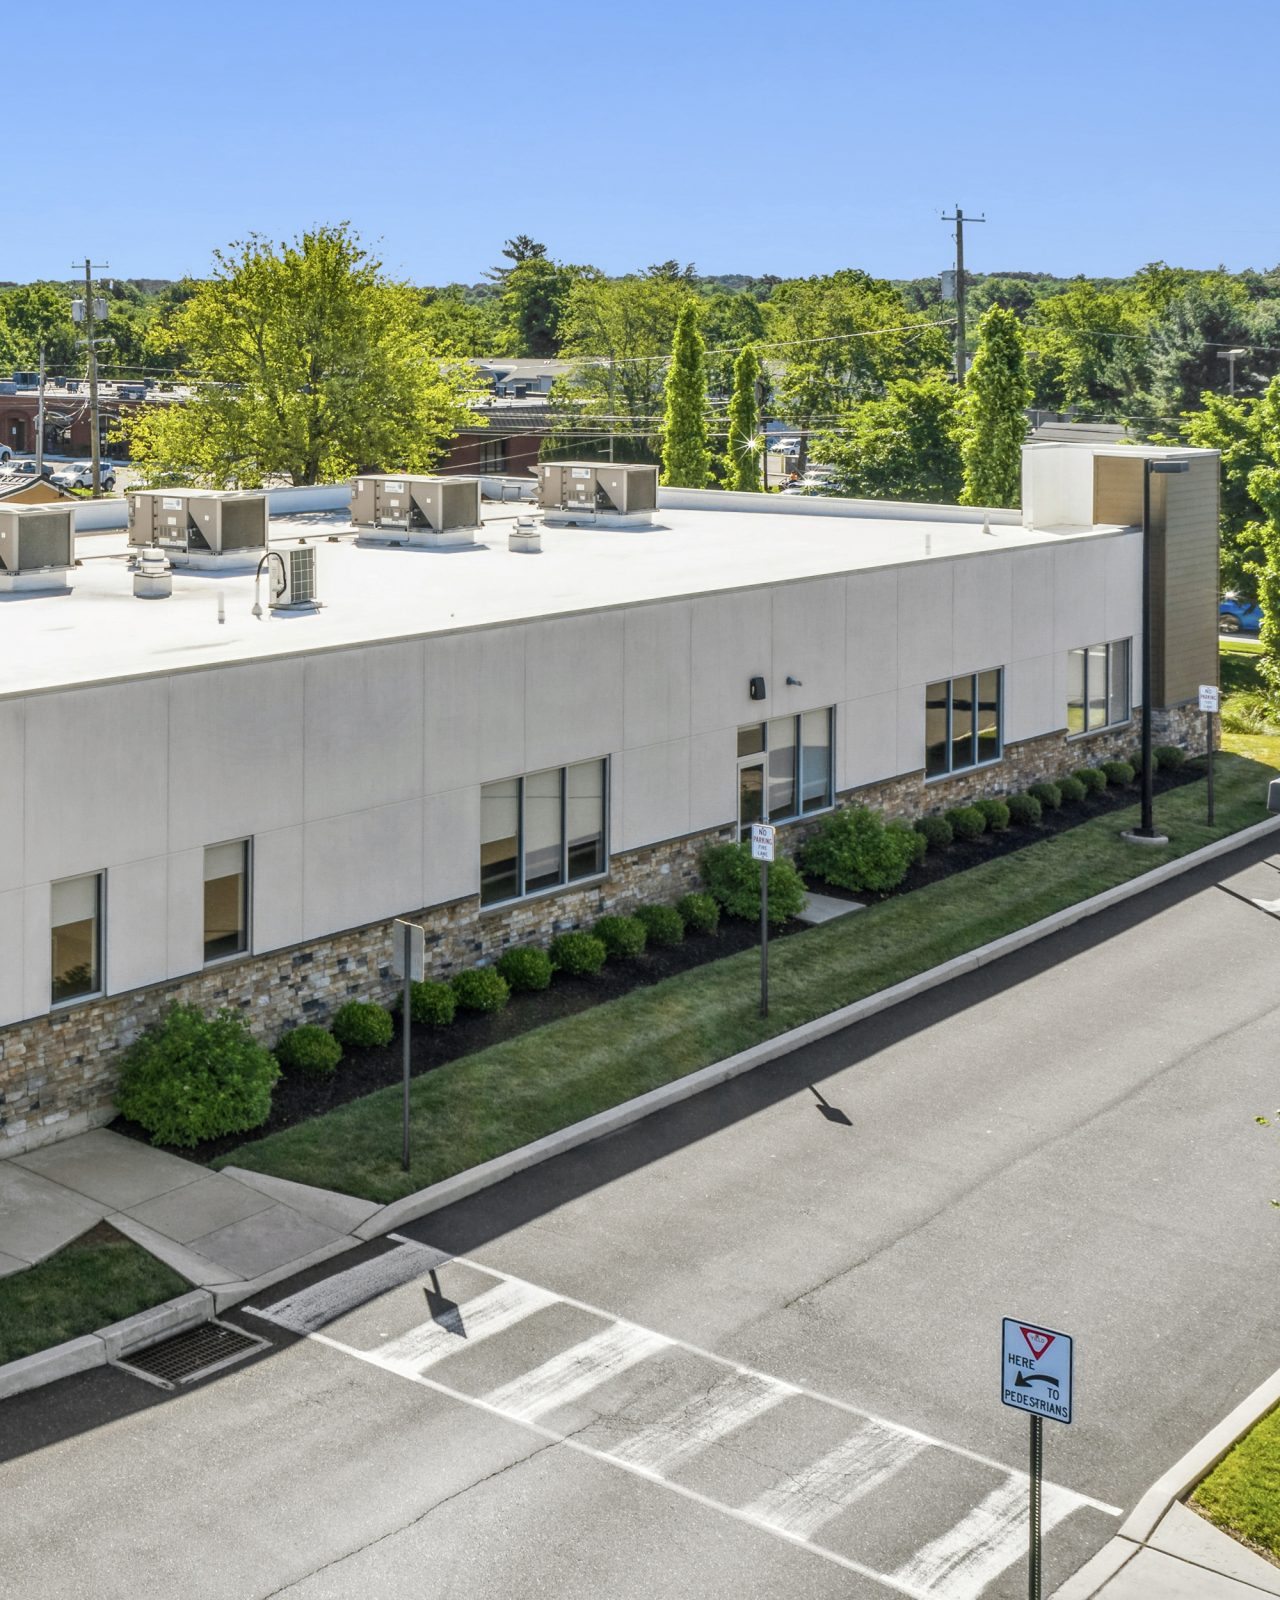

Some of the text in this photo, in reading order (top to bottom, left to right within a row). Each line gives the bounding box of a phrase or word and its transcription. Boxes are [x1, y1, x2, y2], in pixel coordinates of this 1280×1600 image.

[753, 836, 772, 845] PARKING
[1031, 1335, 1044, 1343] YIELD
[1008, 1353, 1035, 1370] HERE
[1047, 1387, 1059, 1400] TO
[1005, 1389, 1068, 1417] PEDESTRIANS
